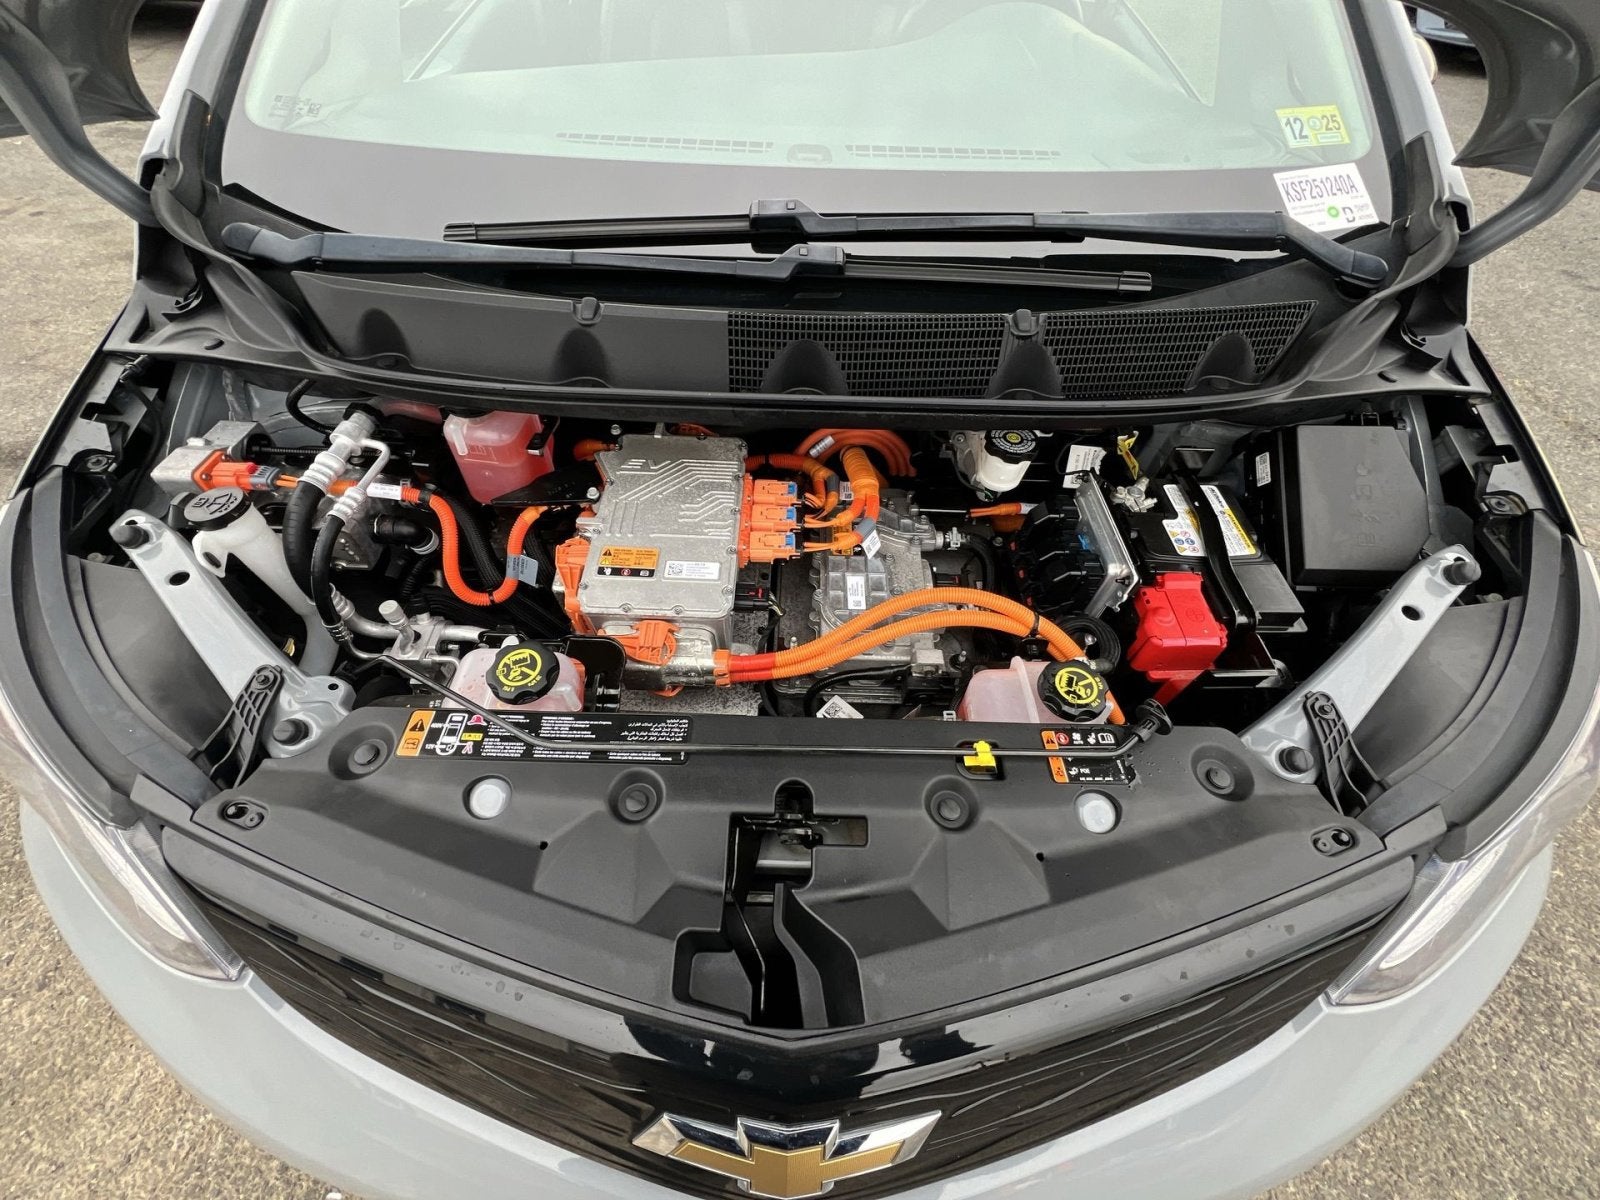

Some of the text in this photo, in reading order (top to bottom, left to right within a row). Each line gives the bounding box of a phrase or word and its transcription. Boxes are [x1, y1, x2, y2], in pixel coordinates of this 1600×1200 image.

[1284, 117, 1309, 141] 12
[1321, 114, 1341, 132] 25
[1281, 174, 1359, 204] KSF251240A
